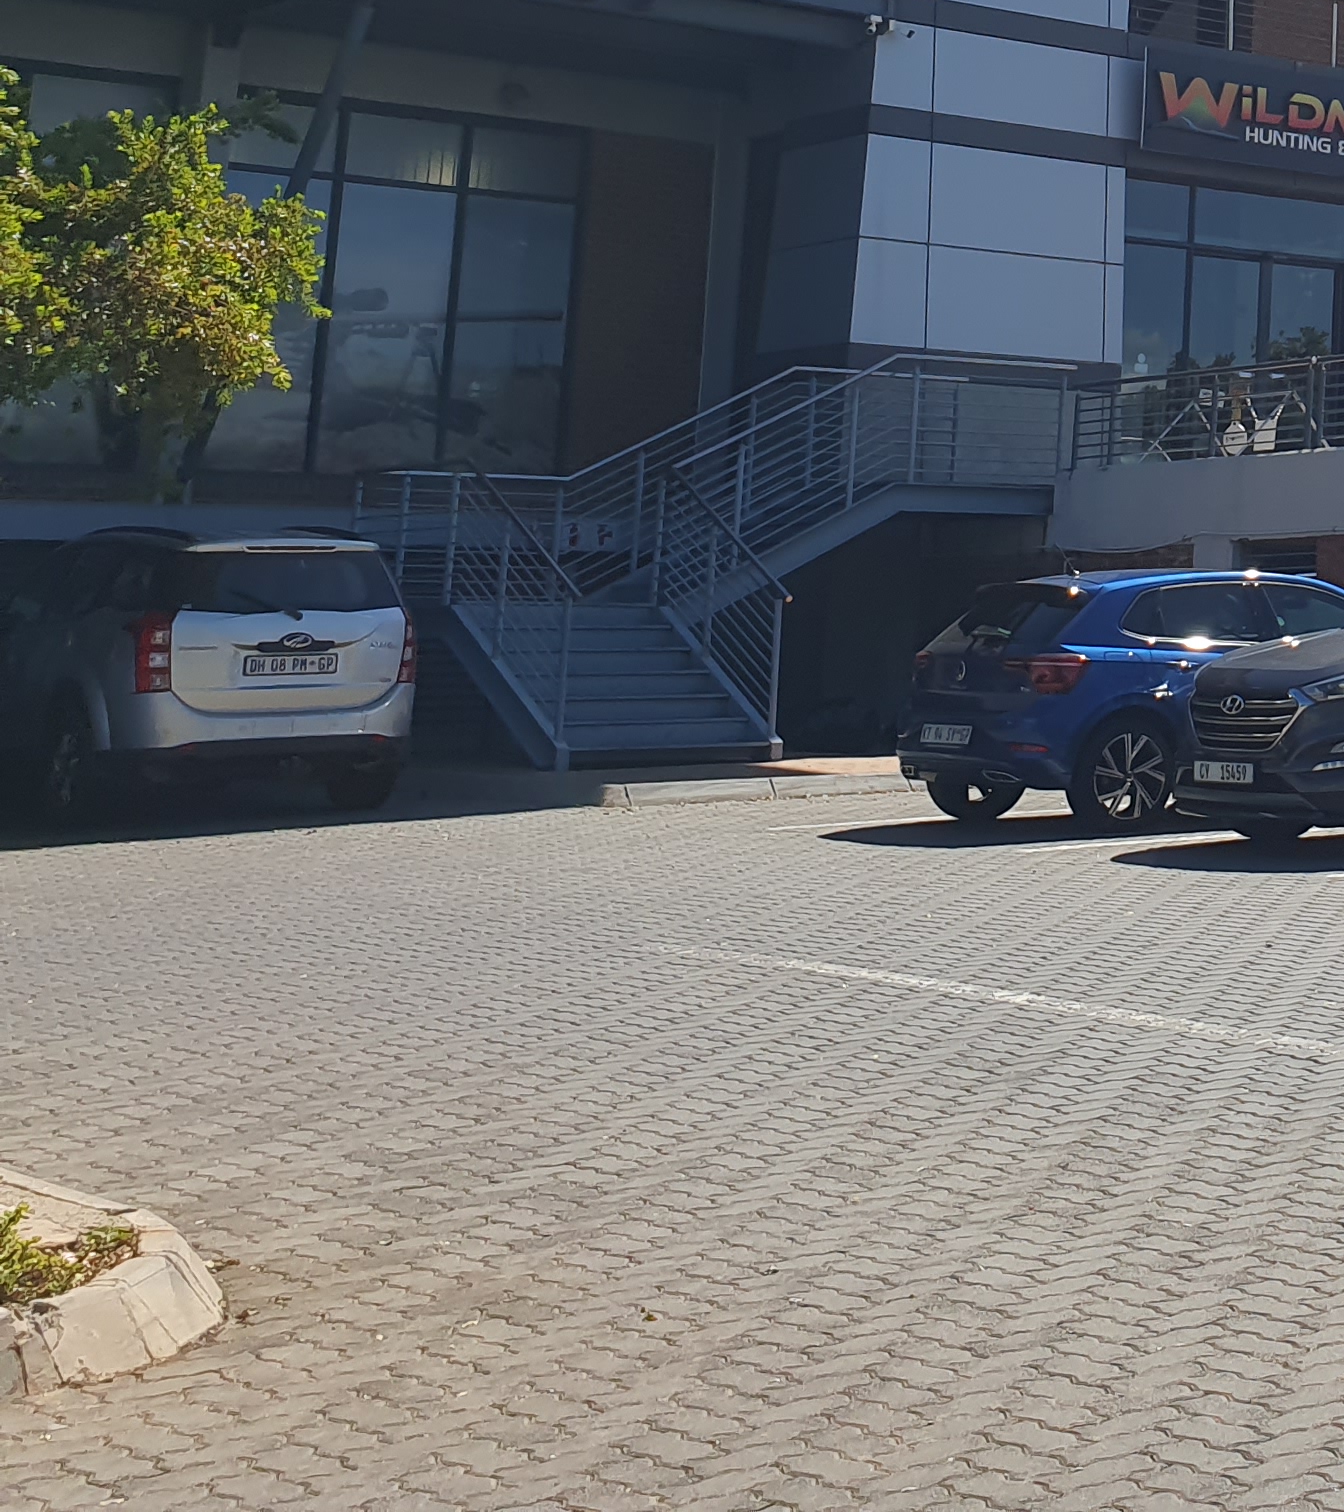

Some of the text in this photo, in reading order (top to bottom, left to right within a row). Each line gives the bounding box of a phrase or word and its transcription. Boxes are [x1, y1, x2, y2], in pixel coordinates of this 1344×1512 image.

[1245, 126, 1332, 154] HUNTING
[271, 656, 286, 672] 08
[318, 655, 335, 670] GP
[1220, 763, 1247, 781] 15459
